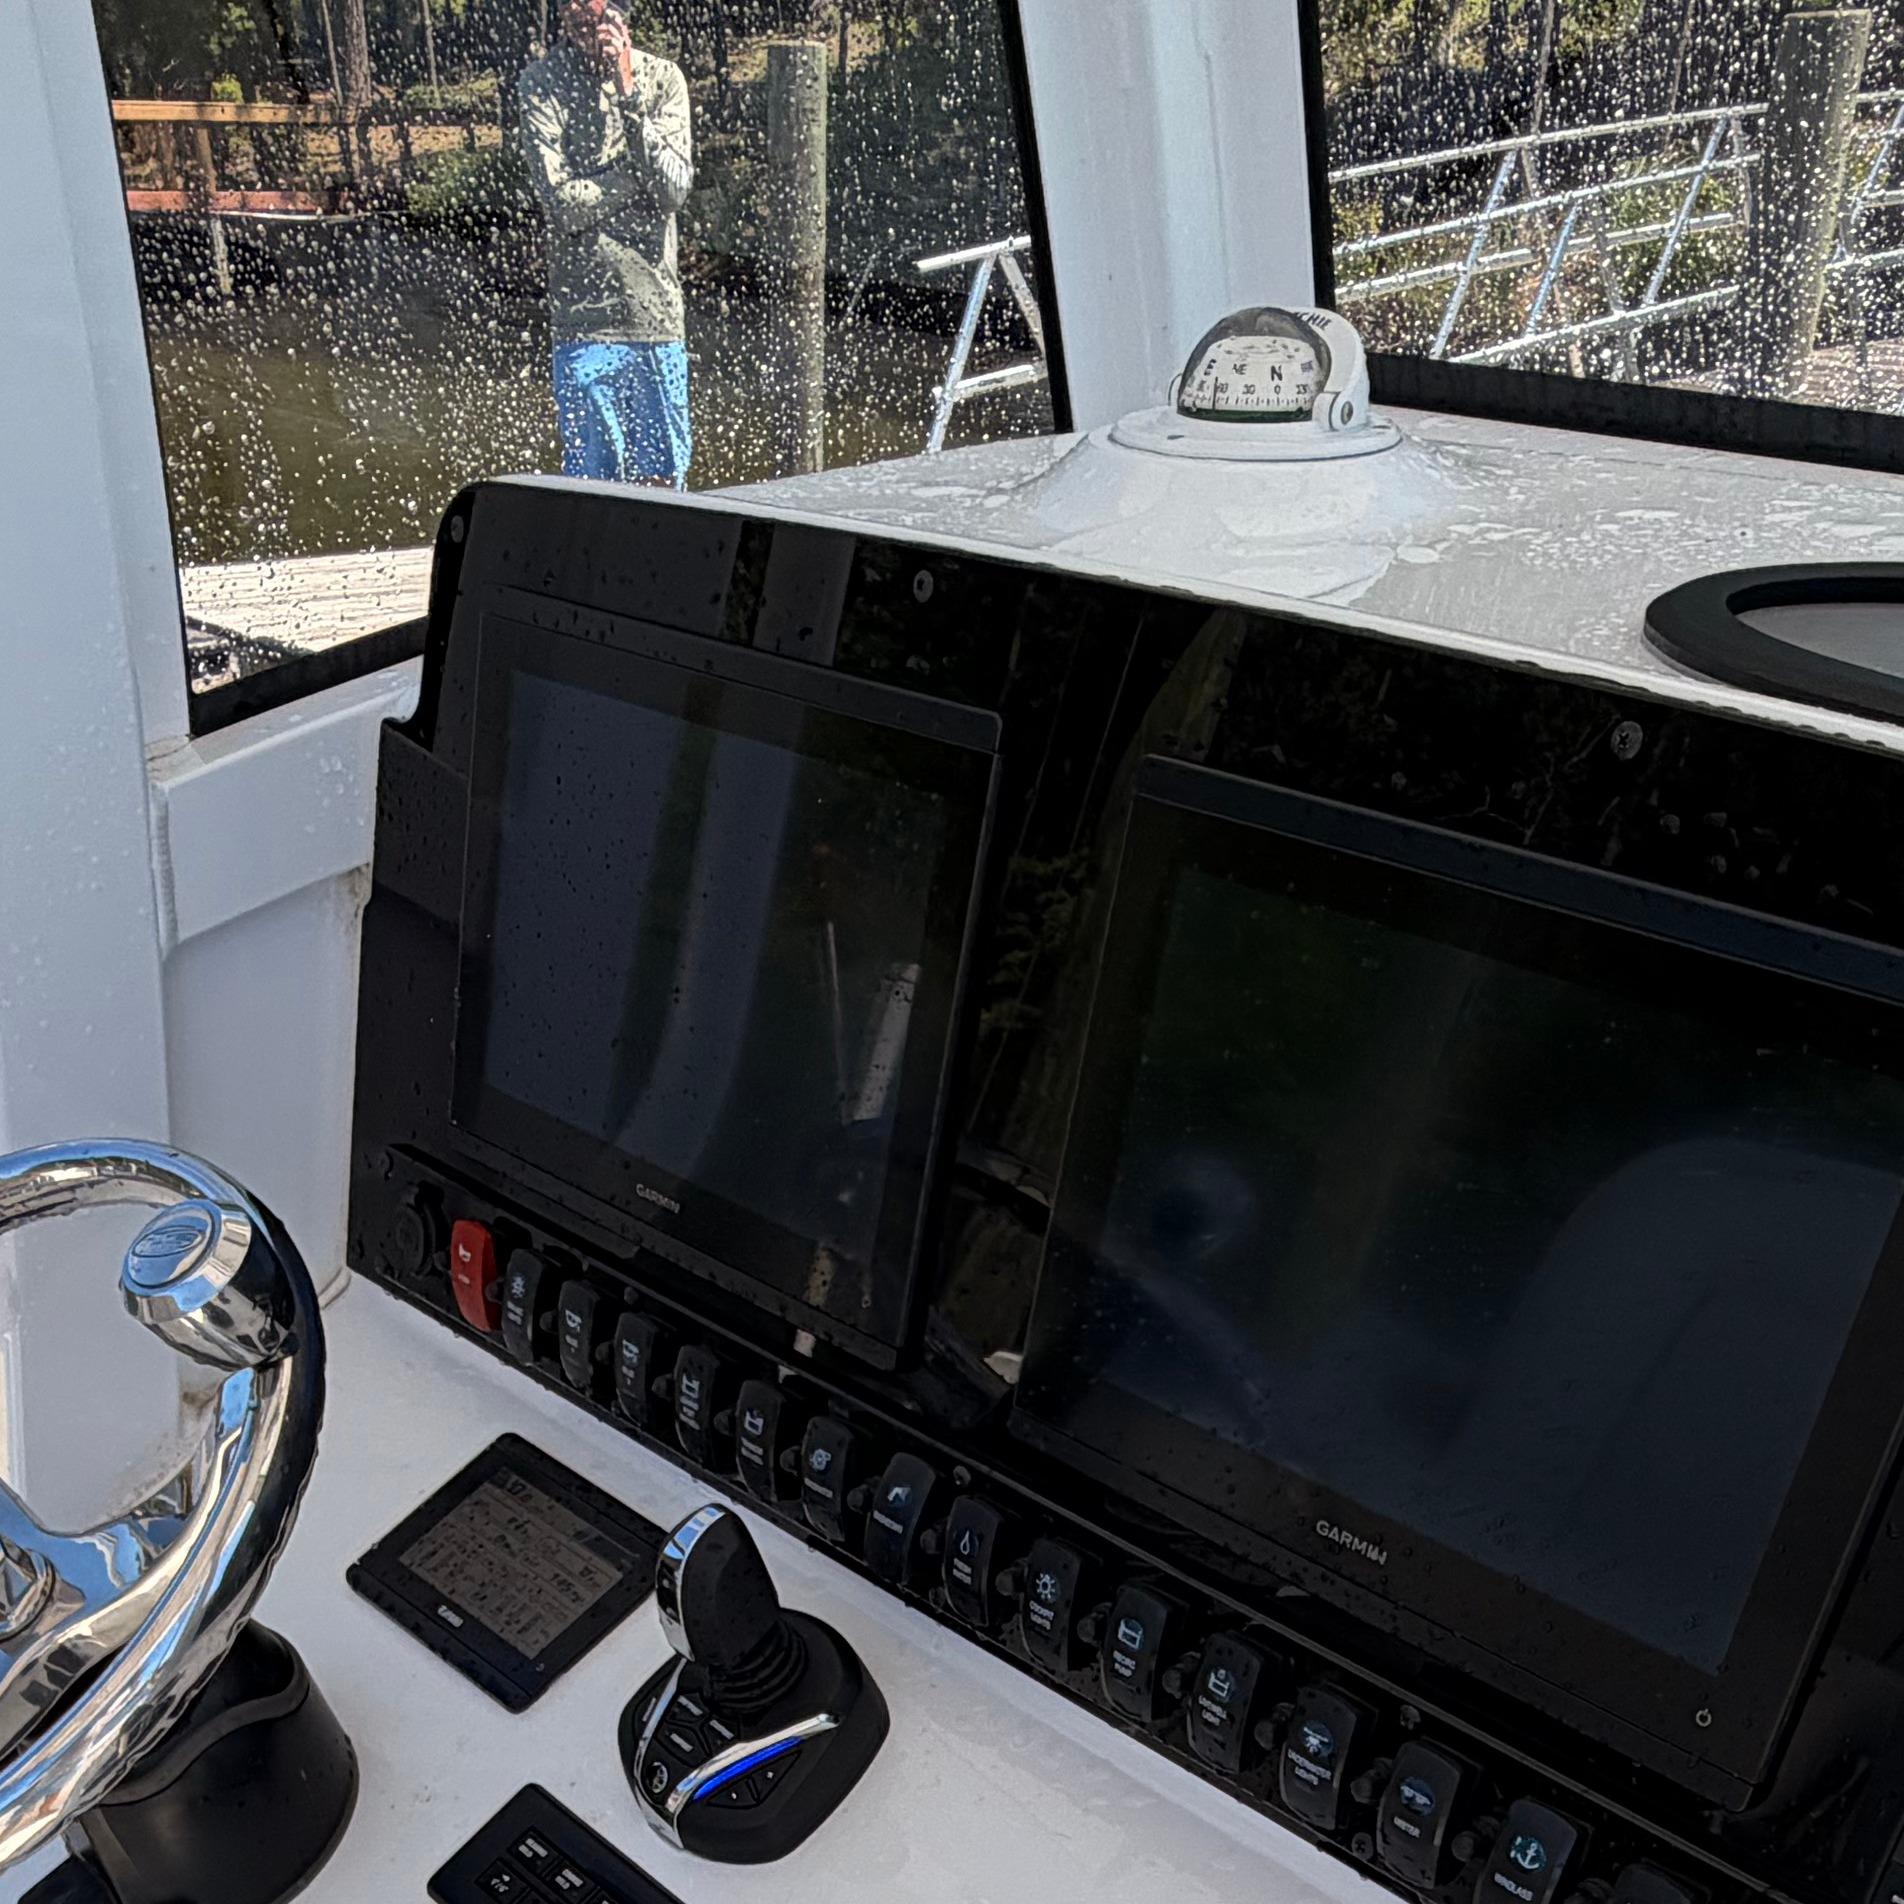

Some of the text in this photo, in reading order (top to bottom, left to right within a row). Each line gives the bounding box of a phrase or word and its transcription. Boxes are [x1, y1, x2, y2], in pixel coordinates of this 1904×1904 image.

[1270, 364, 1284, 382] N
[636, 1183, 681, 1214] GARMIN
[1315, 1519, 1388, 1566] GARMIN
